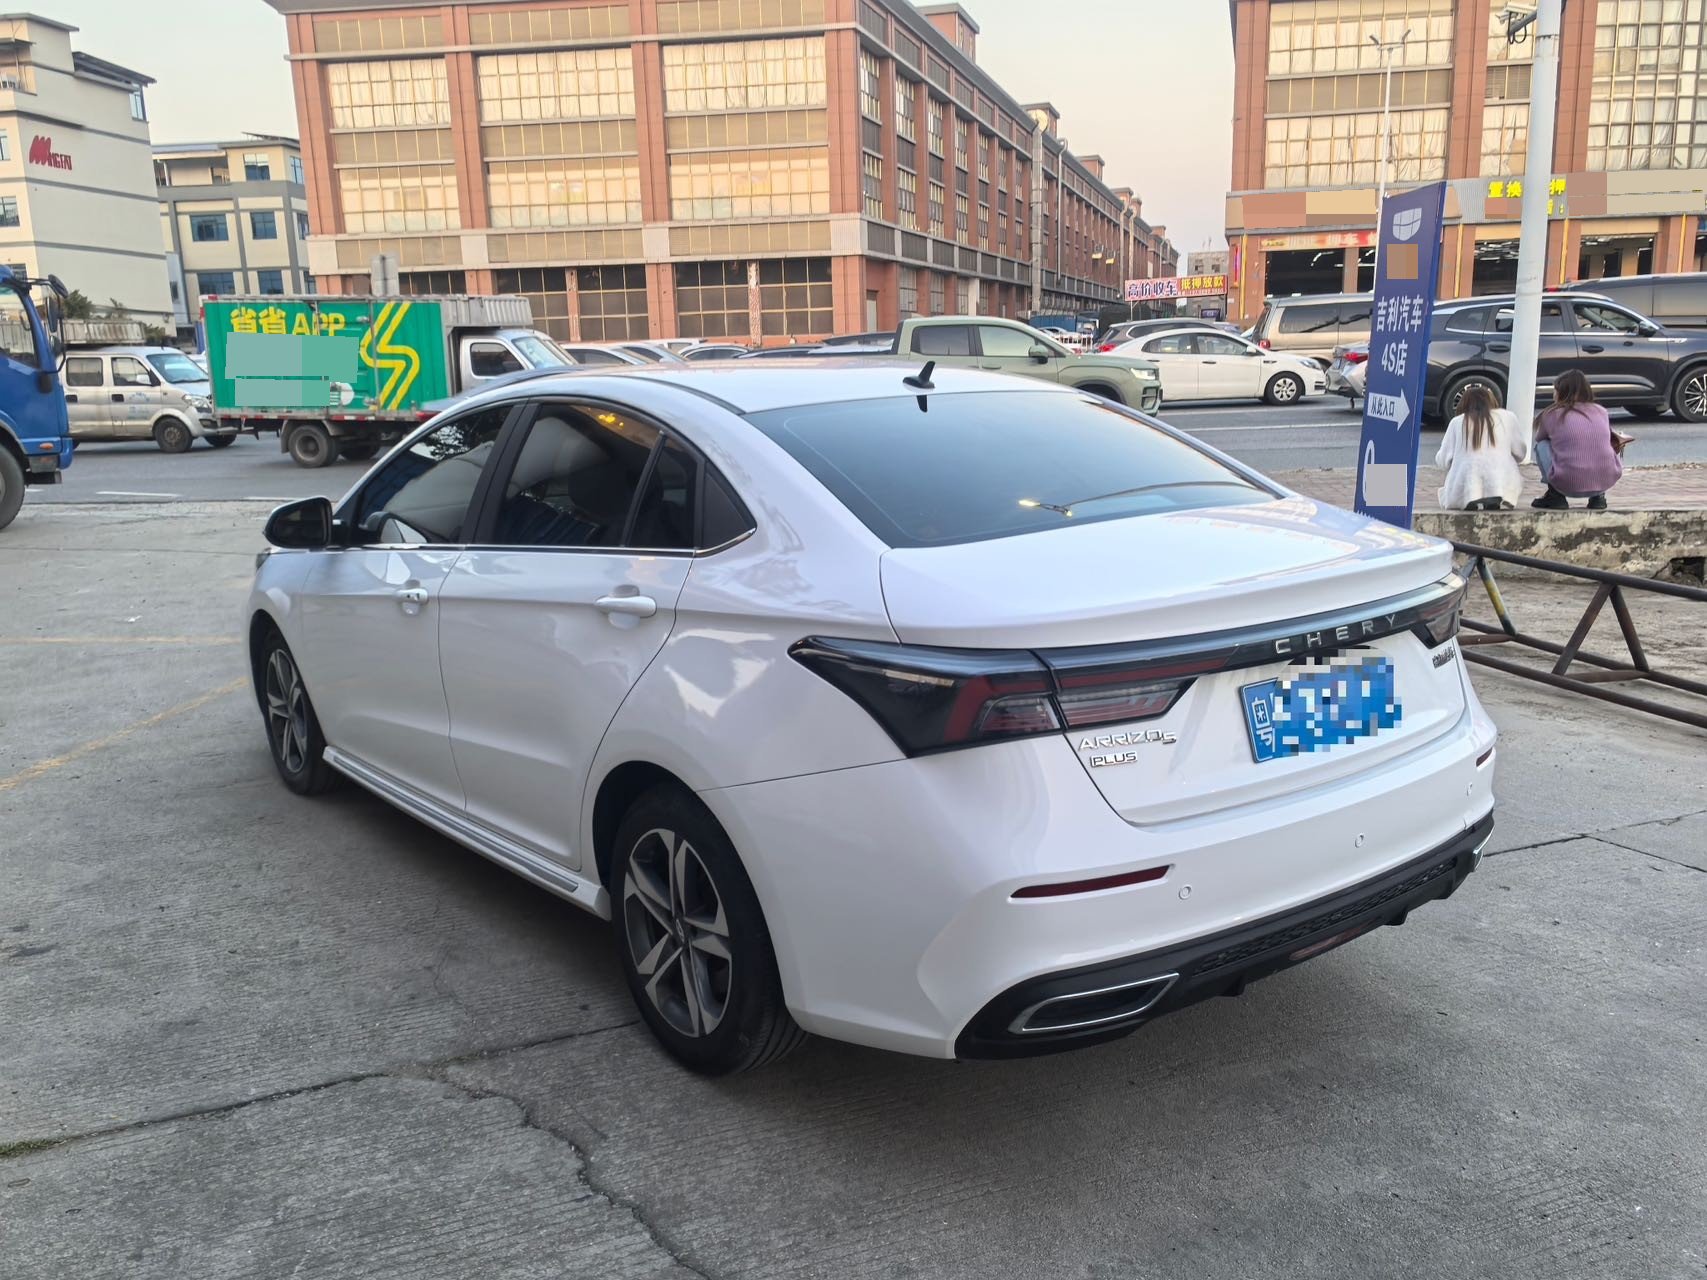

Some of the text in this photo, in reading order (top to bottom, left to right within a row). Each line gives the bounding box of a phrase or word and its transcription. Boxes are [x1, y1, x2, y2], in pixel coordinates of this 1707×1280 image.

[1128, 281, 1178, 298] 高价收车
[1376, 294, 1424, 333] 吉利汽车
[1381, 339, 1408, 377] 4S店
[1371, 395, 1395, 418] 从此入口
[1275, 614, 1395, 654] CHERY
[1090, 751, 1138, 768] PLUS
